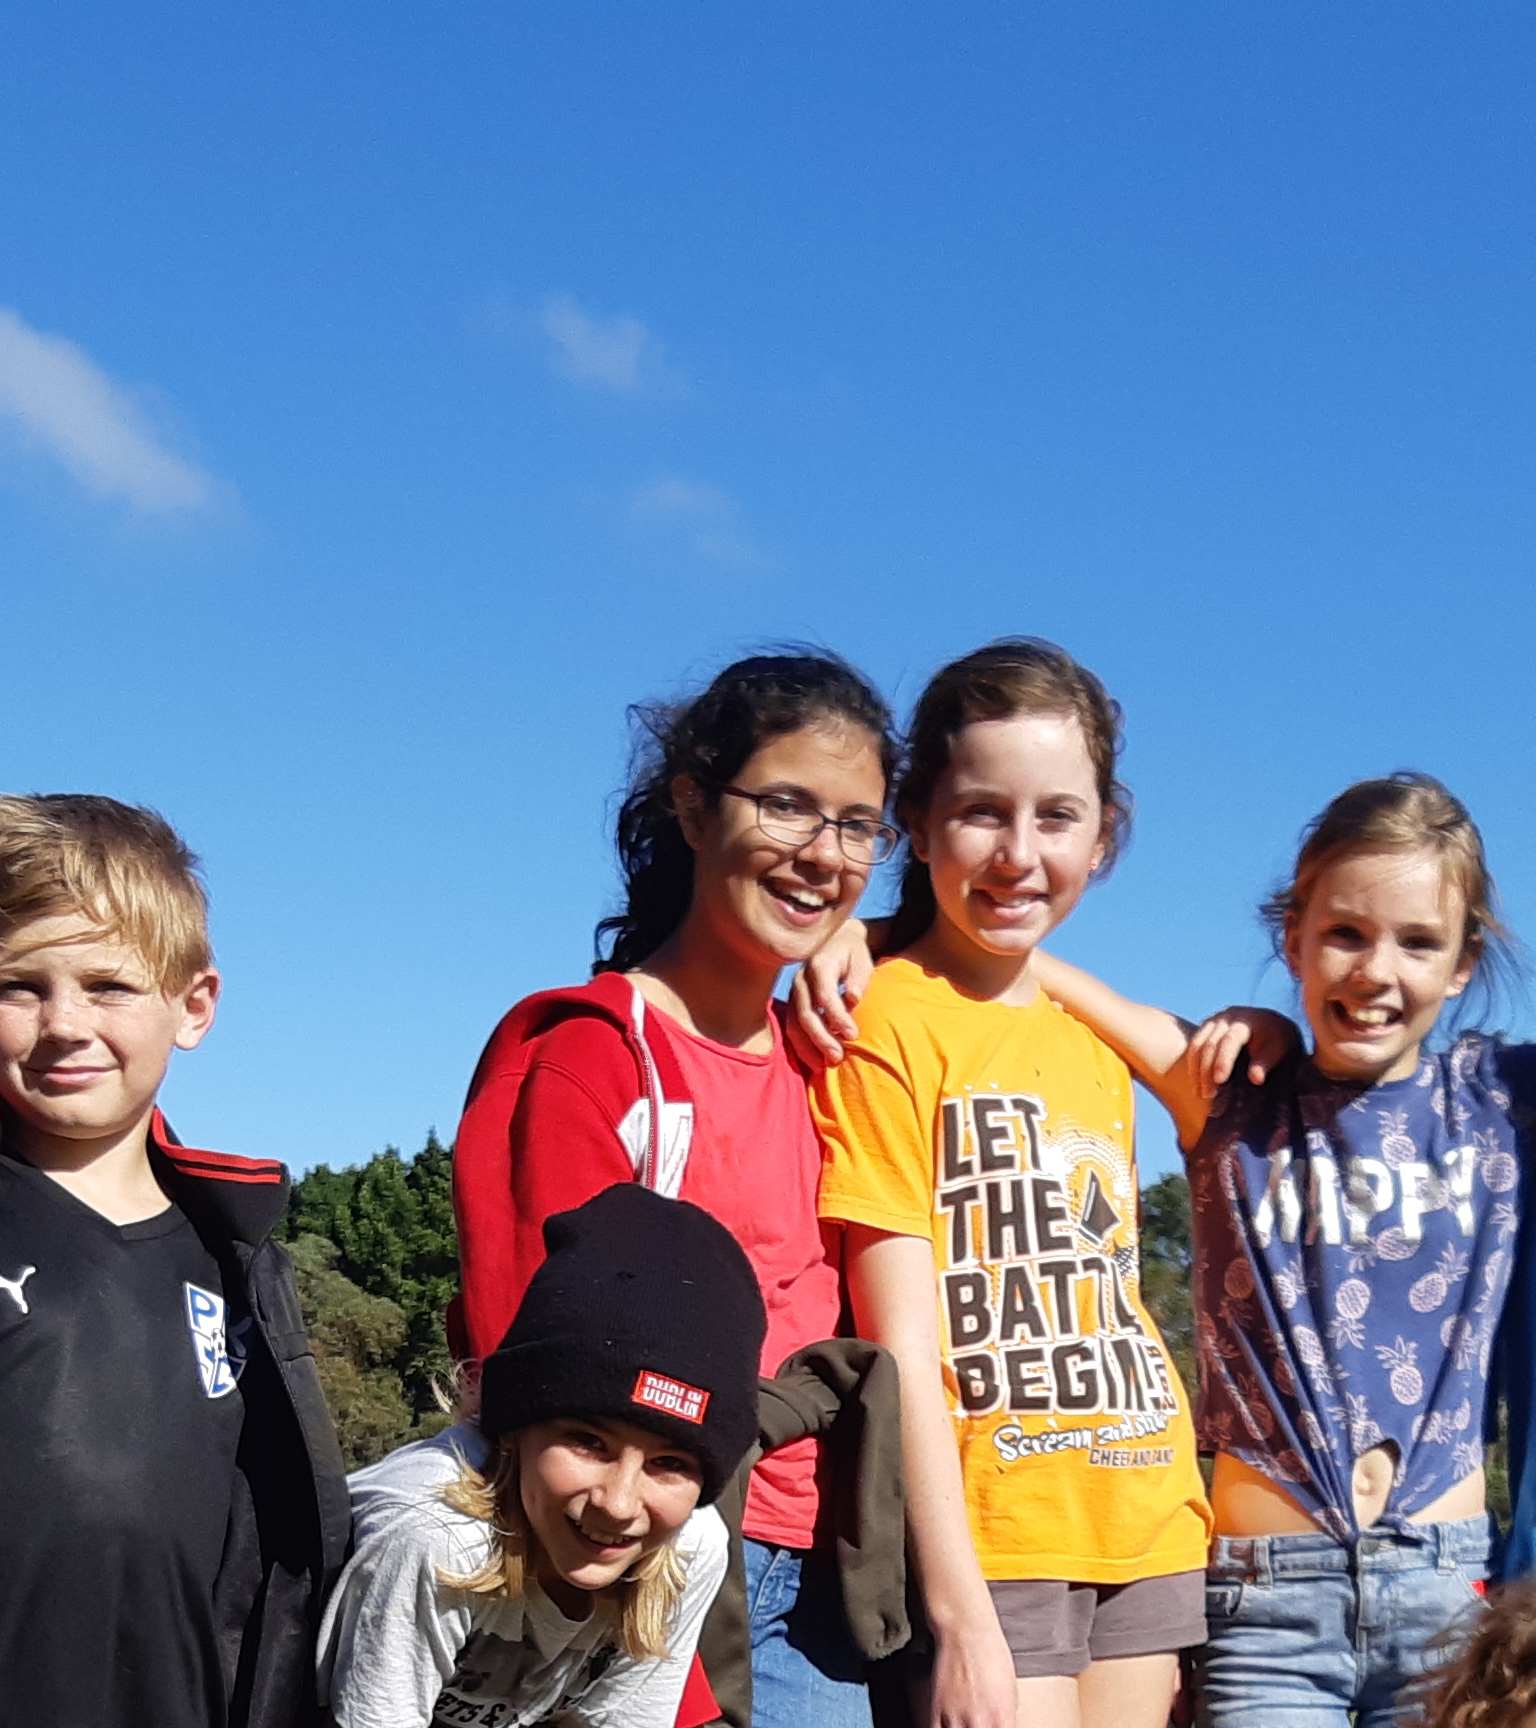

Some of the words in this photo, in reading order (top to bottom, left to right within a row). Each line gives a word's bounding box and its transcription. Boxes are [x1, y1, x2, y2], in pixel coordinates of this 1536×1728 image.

[940, 1096, 1043, 1184] LET
[939, 1176, 1076, 1265] THE
[992, 1423, 1093, 1462] Scream
